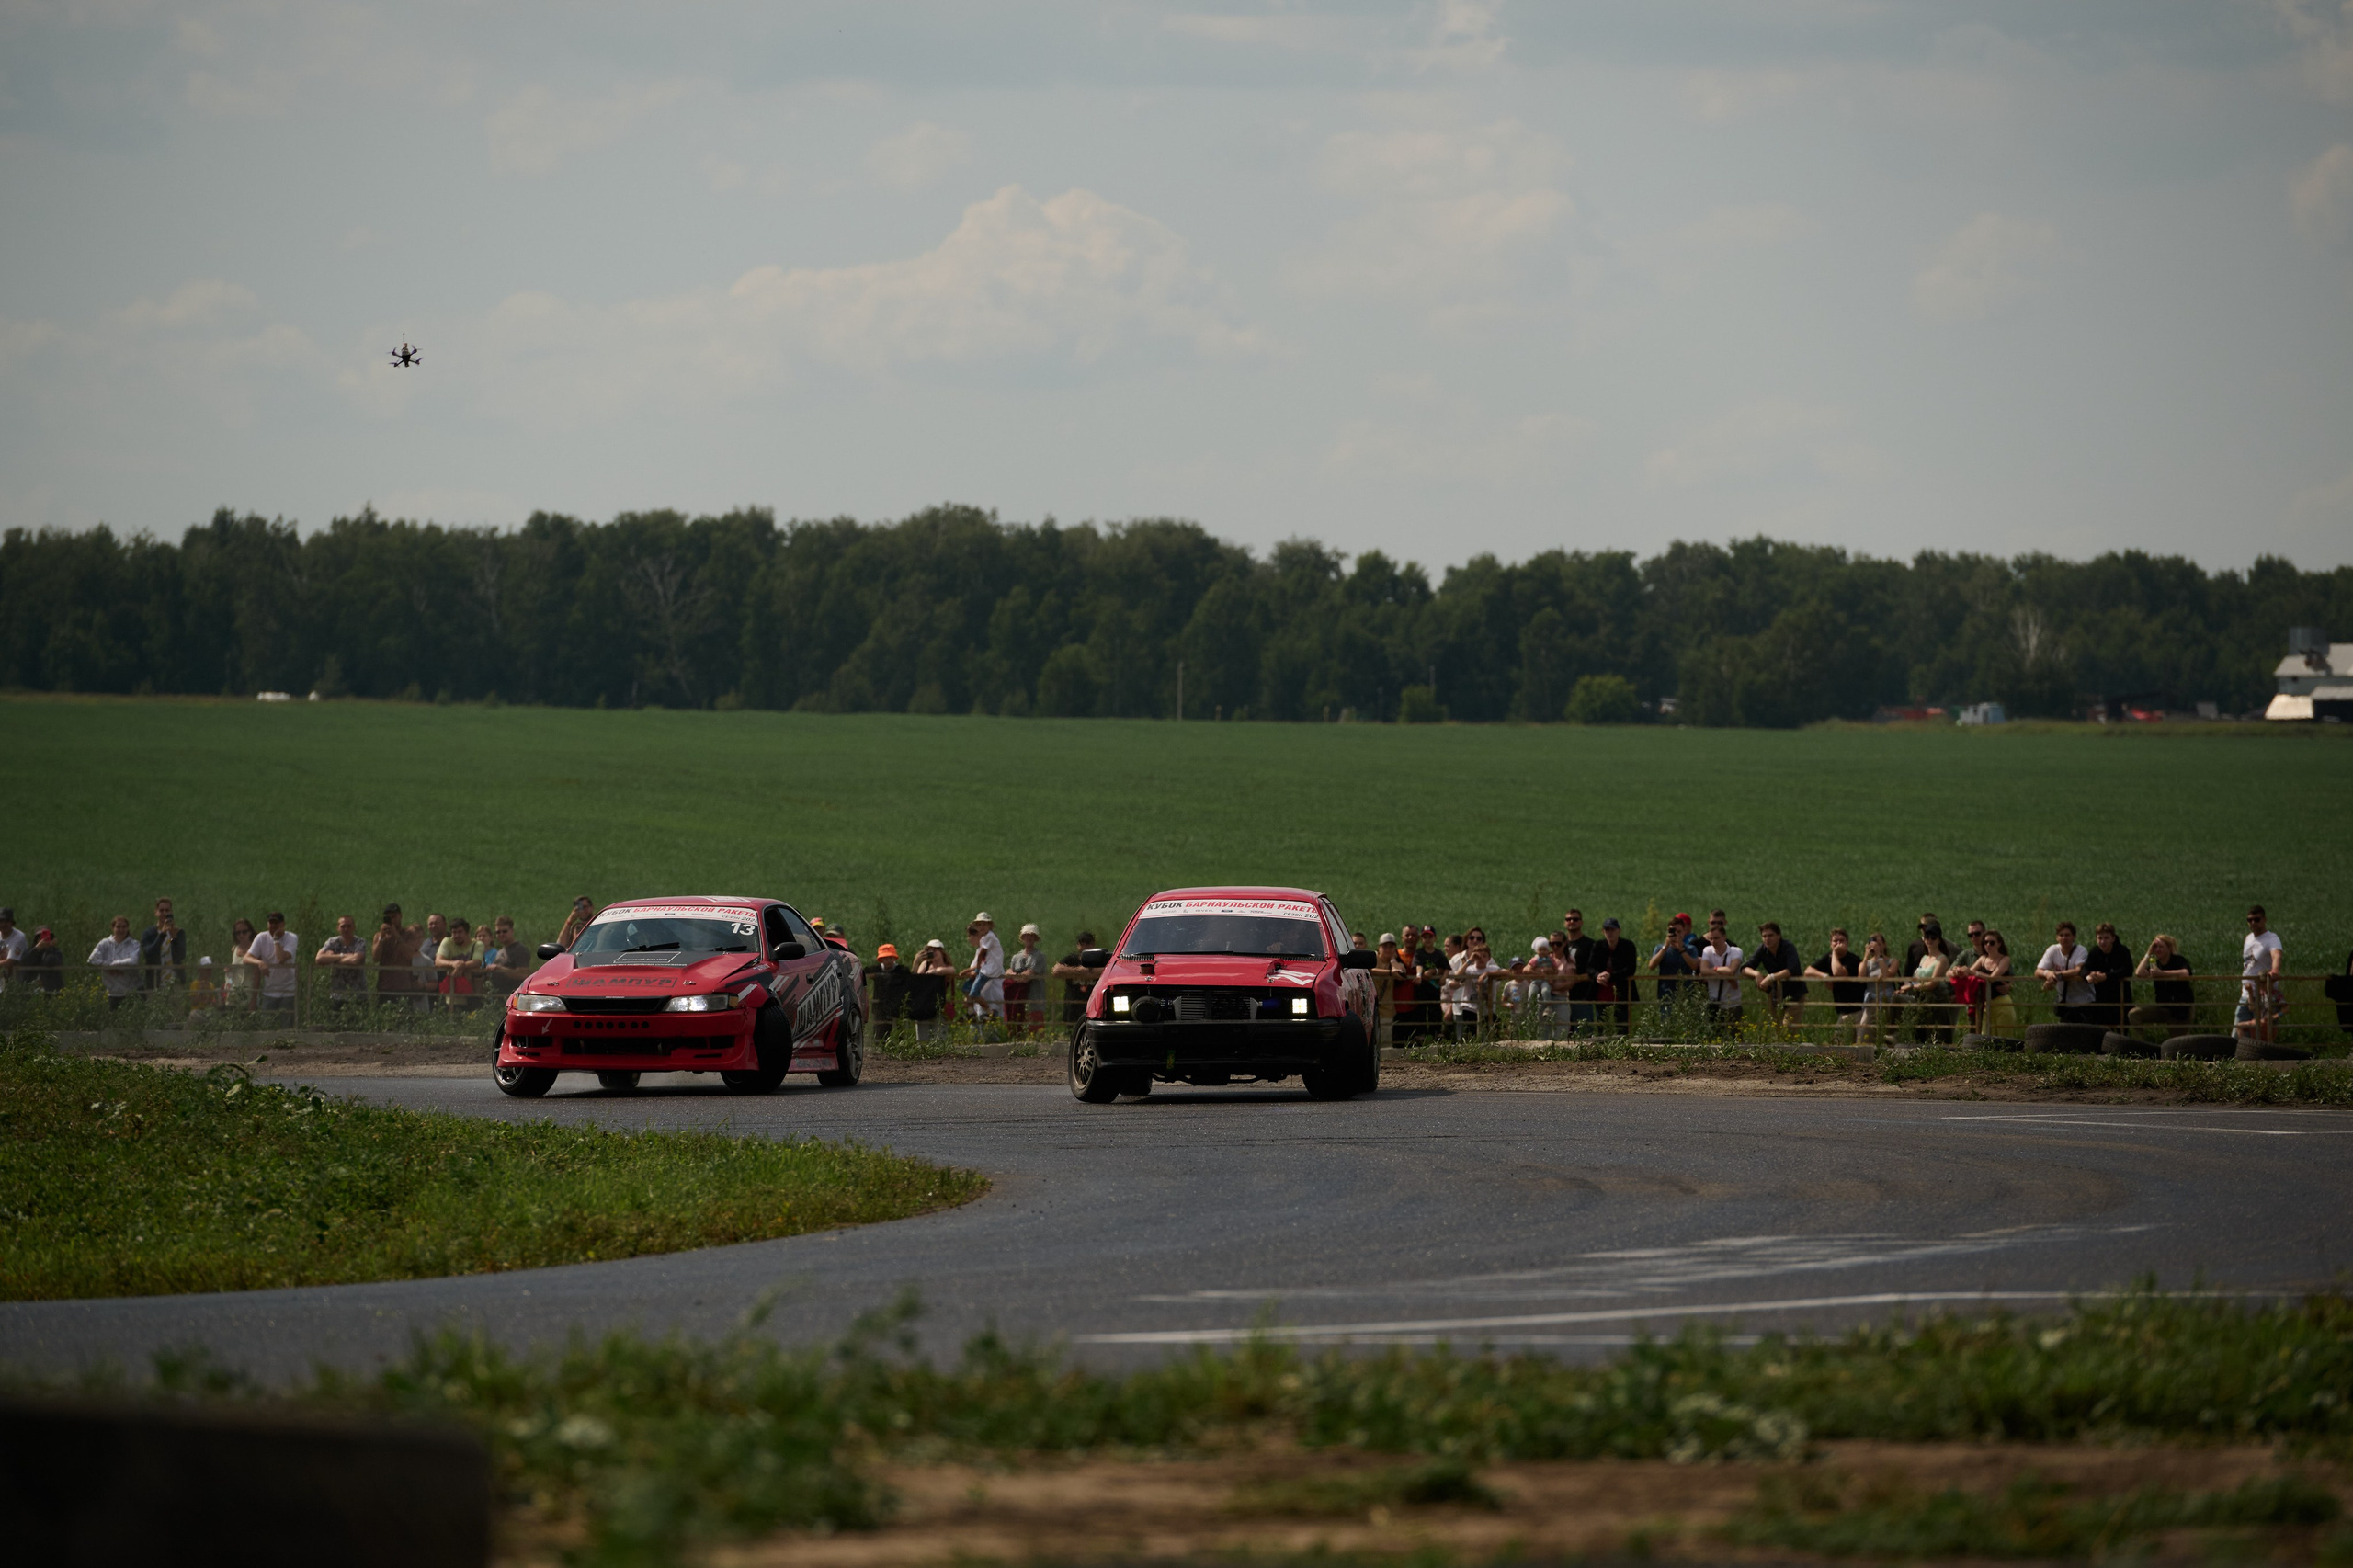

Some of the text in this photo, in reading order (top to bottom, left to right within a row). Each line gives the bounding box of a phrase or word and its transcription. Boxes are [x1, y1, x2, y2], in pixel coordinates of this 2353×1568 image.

[599, 908, 632, 918] КУБОК
[633, 905, 716, 914] БАРНАУЛЬСКОЙ
[1146, 902, 1184, 910] КУБОК
[1186, 901, 1275, 909] БАРНАУЛЬСКОЙ
[731, 922, 756, 936] 13
[572, 977, 673, 986] ШАМПУР
[795, 974, 838, 1034] ШАМПУР
